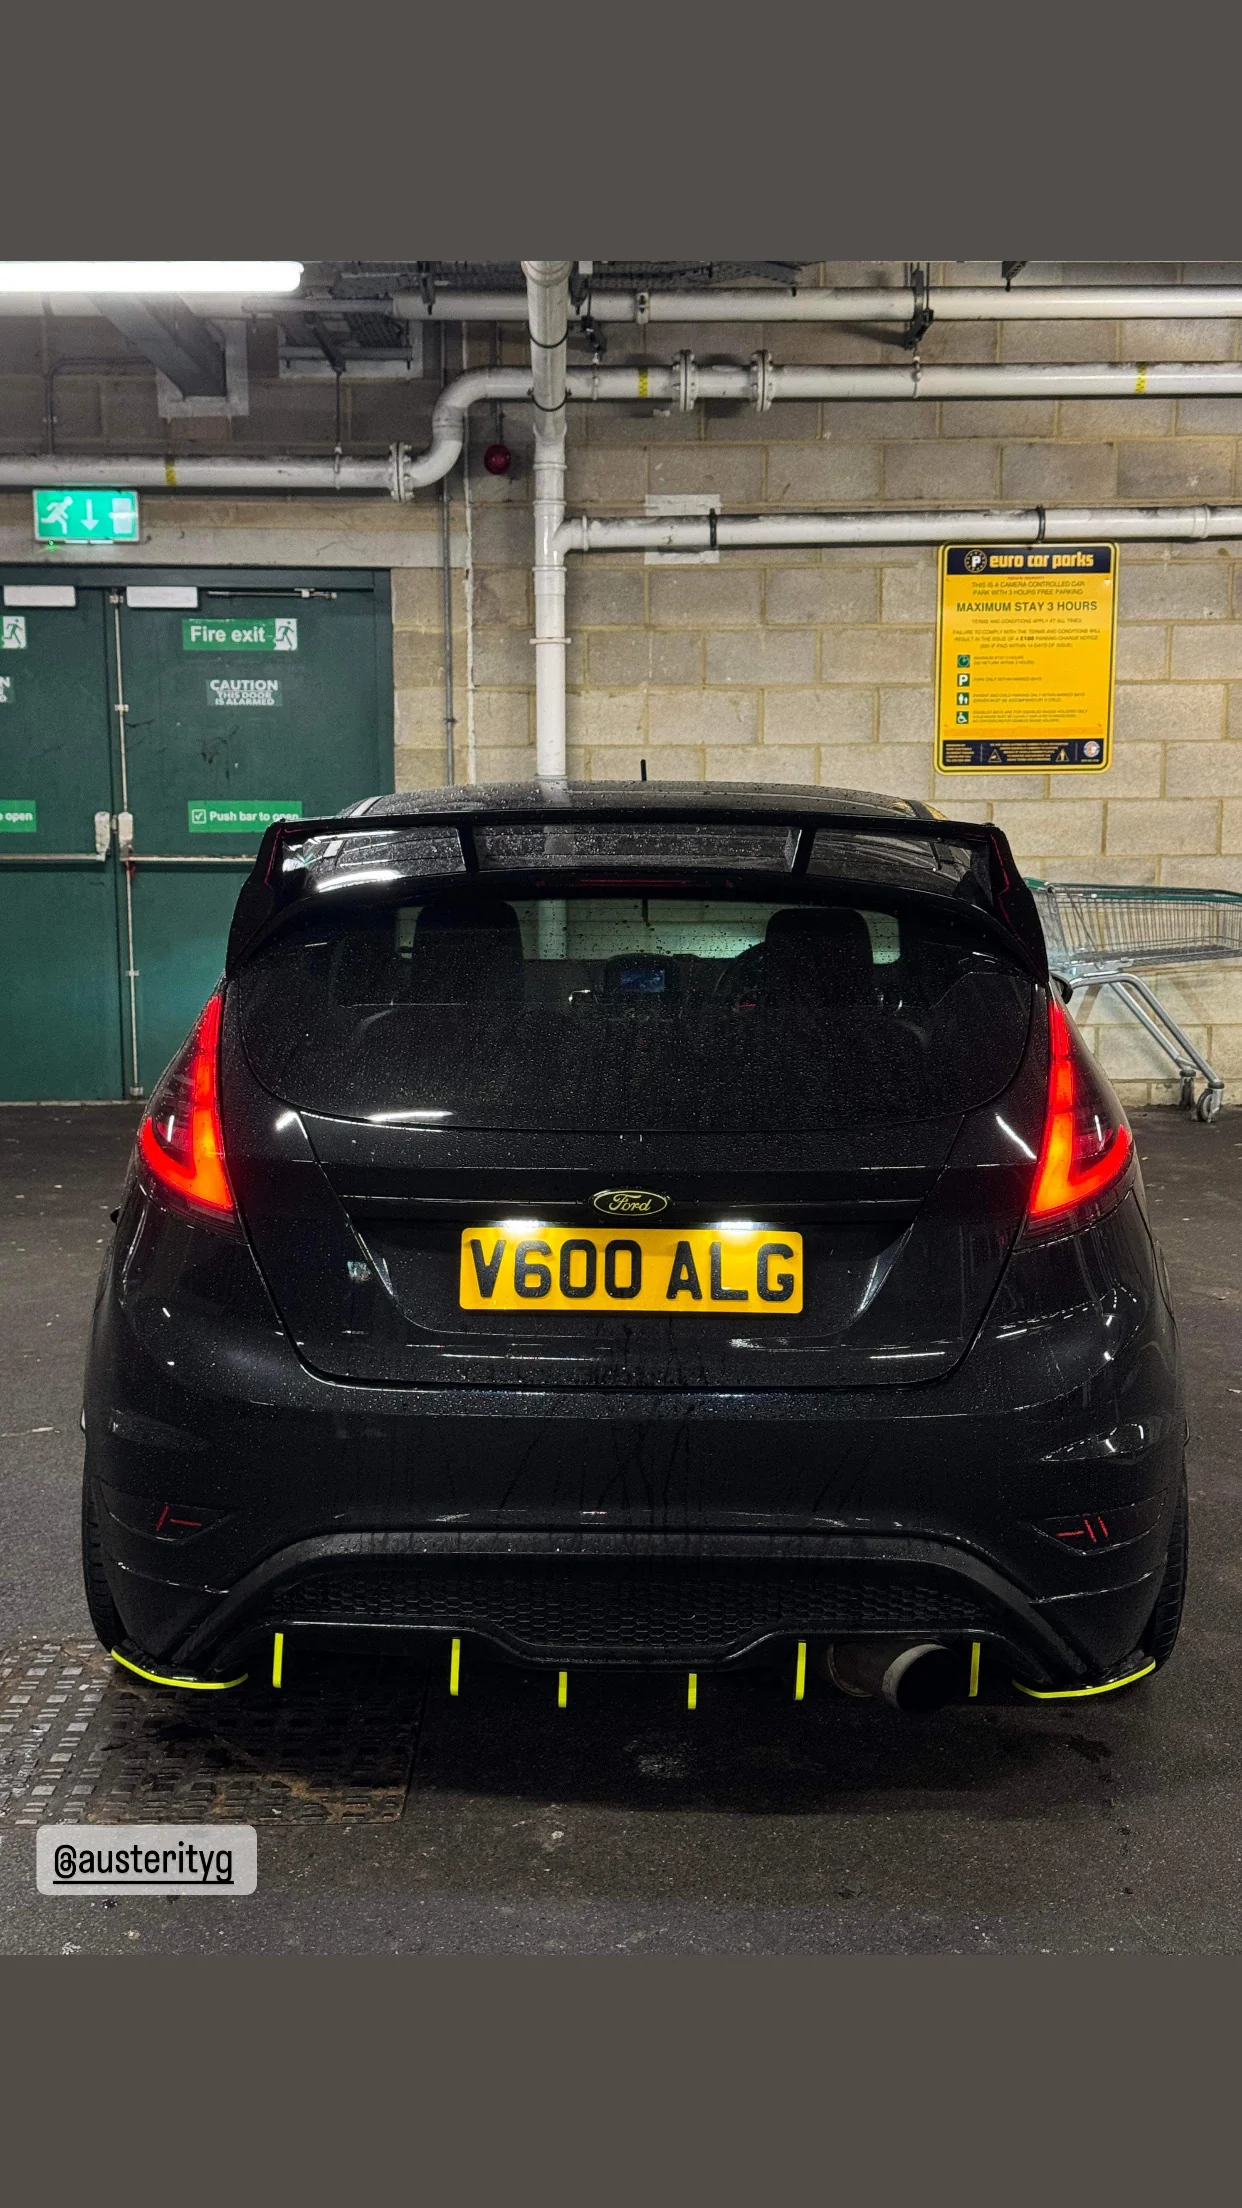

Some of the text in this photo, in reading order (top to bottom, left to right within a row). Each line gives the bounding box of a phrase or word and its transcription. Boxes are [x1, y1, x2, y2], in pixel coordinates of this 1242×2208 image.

[989, 551, 1094, 569] euro car parks
[1028, 581, 1070, 589] CONTROLLED
[957, 601, 1097, 612] MAXIMUM STAY 3 HOURS
[190, 625, 265, 642] Fire exit
[210, 679, 278, 691] CAUTION
[217, 690, 272, 699] THIS DOOR
[5, 812, 33, 823] open
[209, 811, 237, 821] Push
[239, 811, 257, 821] bar
[259, 811, 268, 821] to
[609, 1193, 651, 1212] Ford
[470, 1238, 794, 1302] V600 ALG
